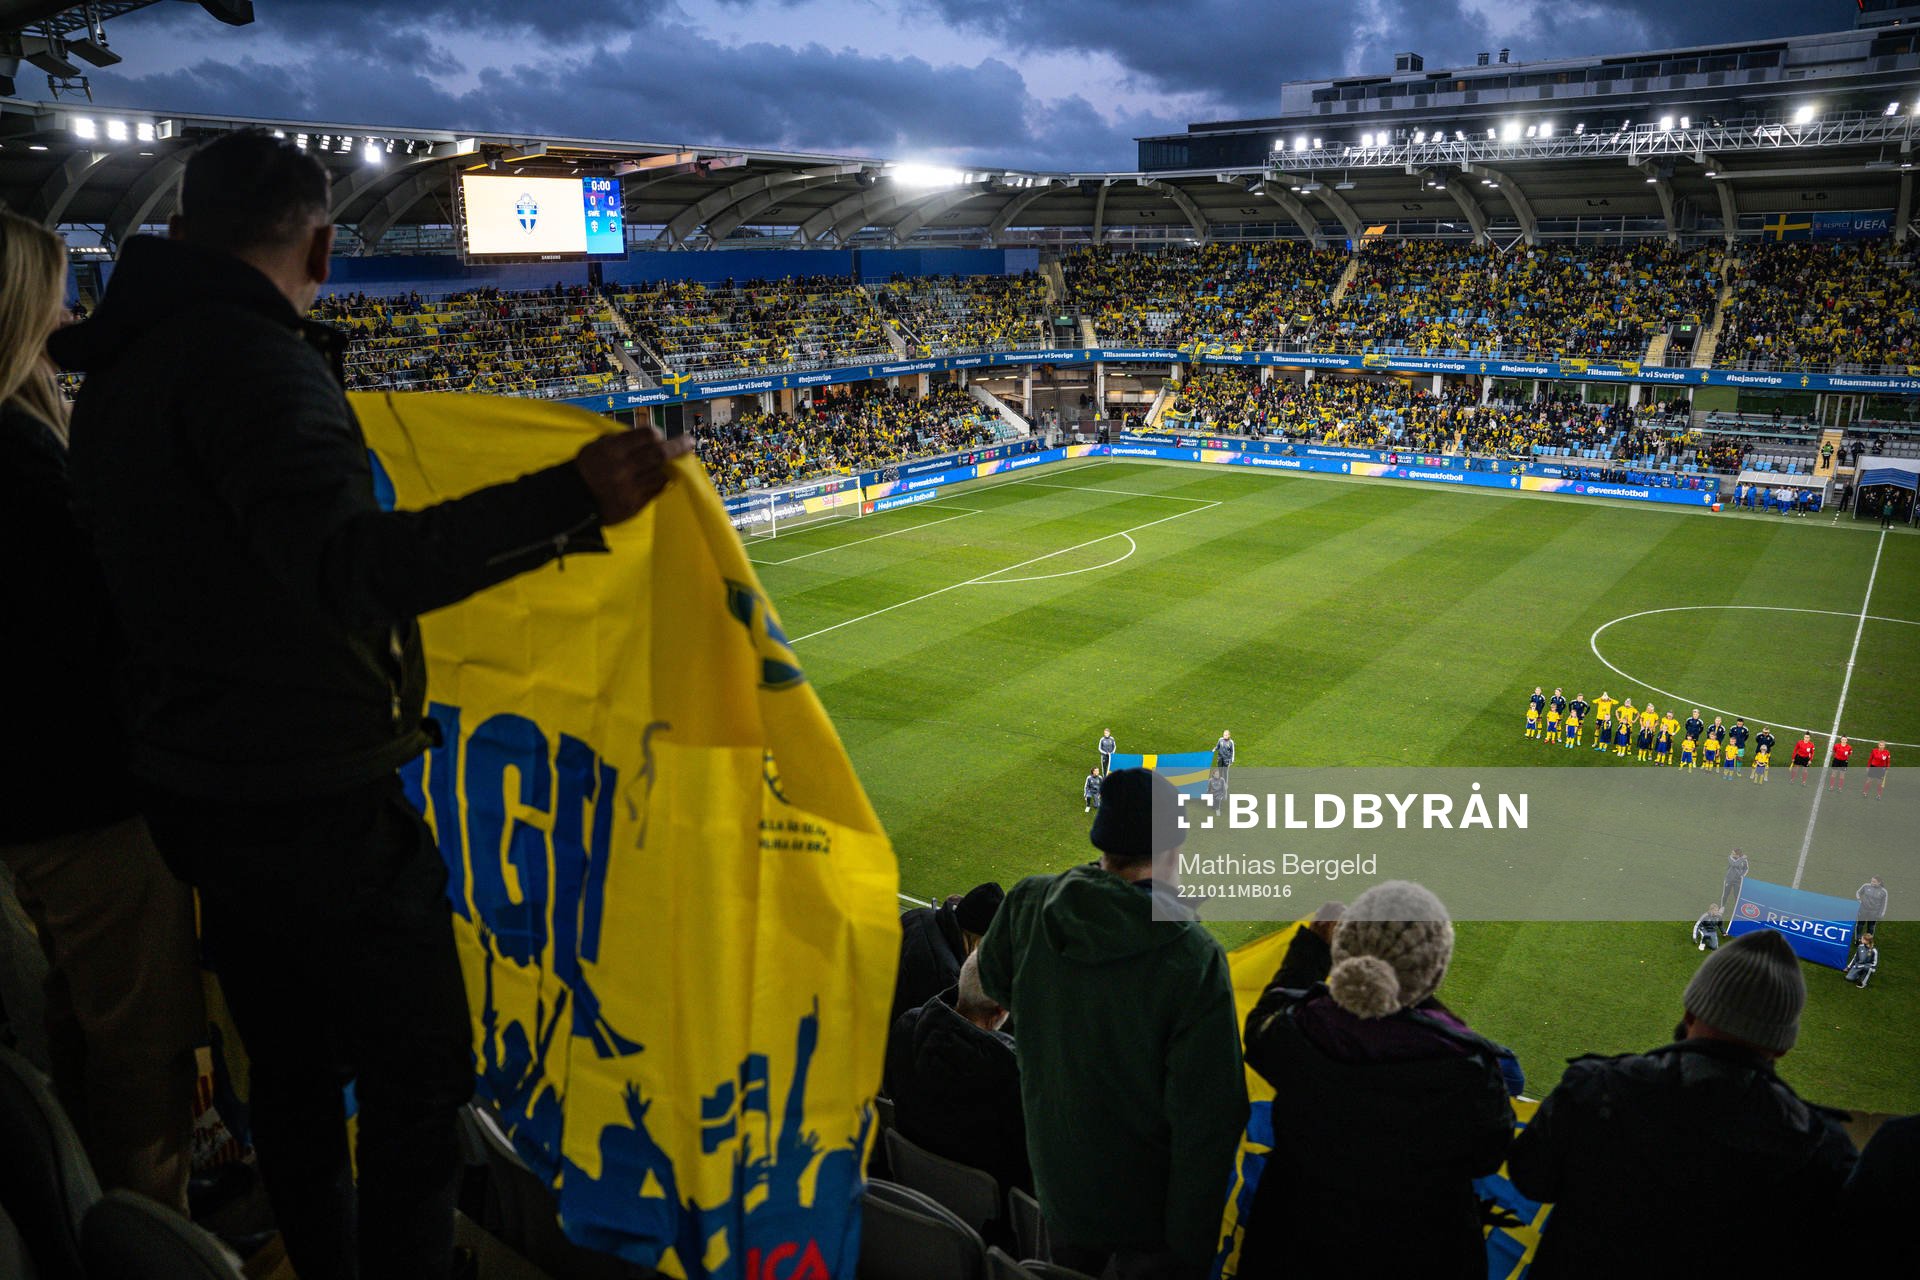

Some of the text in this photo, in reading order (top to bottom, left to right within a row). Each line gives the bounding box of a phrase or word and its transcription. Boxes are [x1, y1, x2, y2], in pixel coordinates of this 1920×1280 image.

[592, 181, 610, 191] 0:00
[590, 196, 596, 206] 0
[609, 196, 614, 206] 0
[1854, 218, 1887, 230] UEFA
[1501, 365, 1548, 373] #hejasverige
[1726, 375, 1782, 384] #hejasverige
[1829, 378, 1887, 387] Tillsammans
[1409, 471, 1463, 481] @svenskfotboll
[1587, 486, 1648, 498] @svenskfotboll
[1767, 912, 1851, 942] RESPECT
[746, 1235, 831, 1280] ICA
